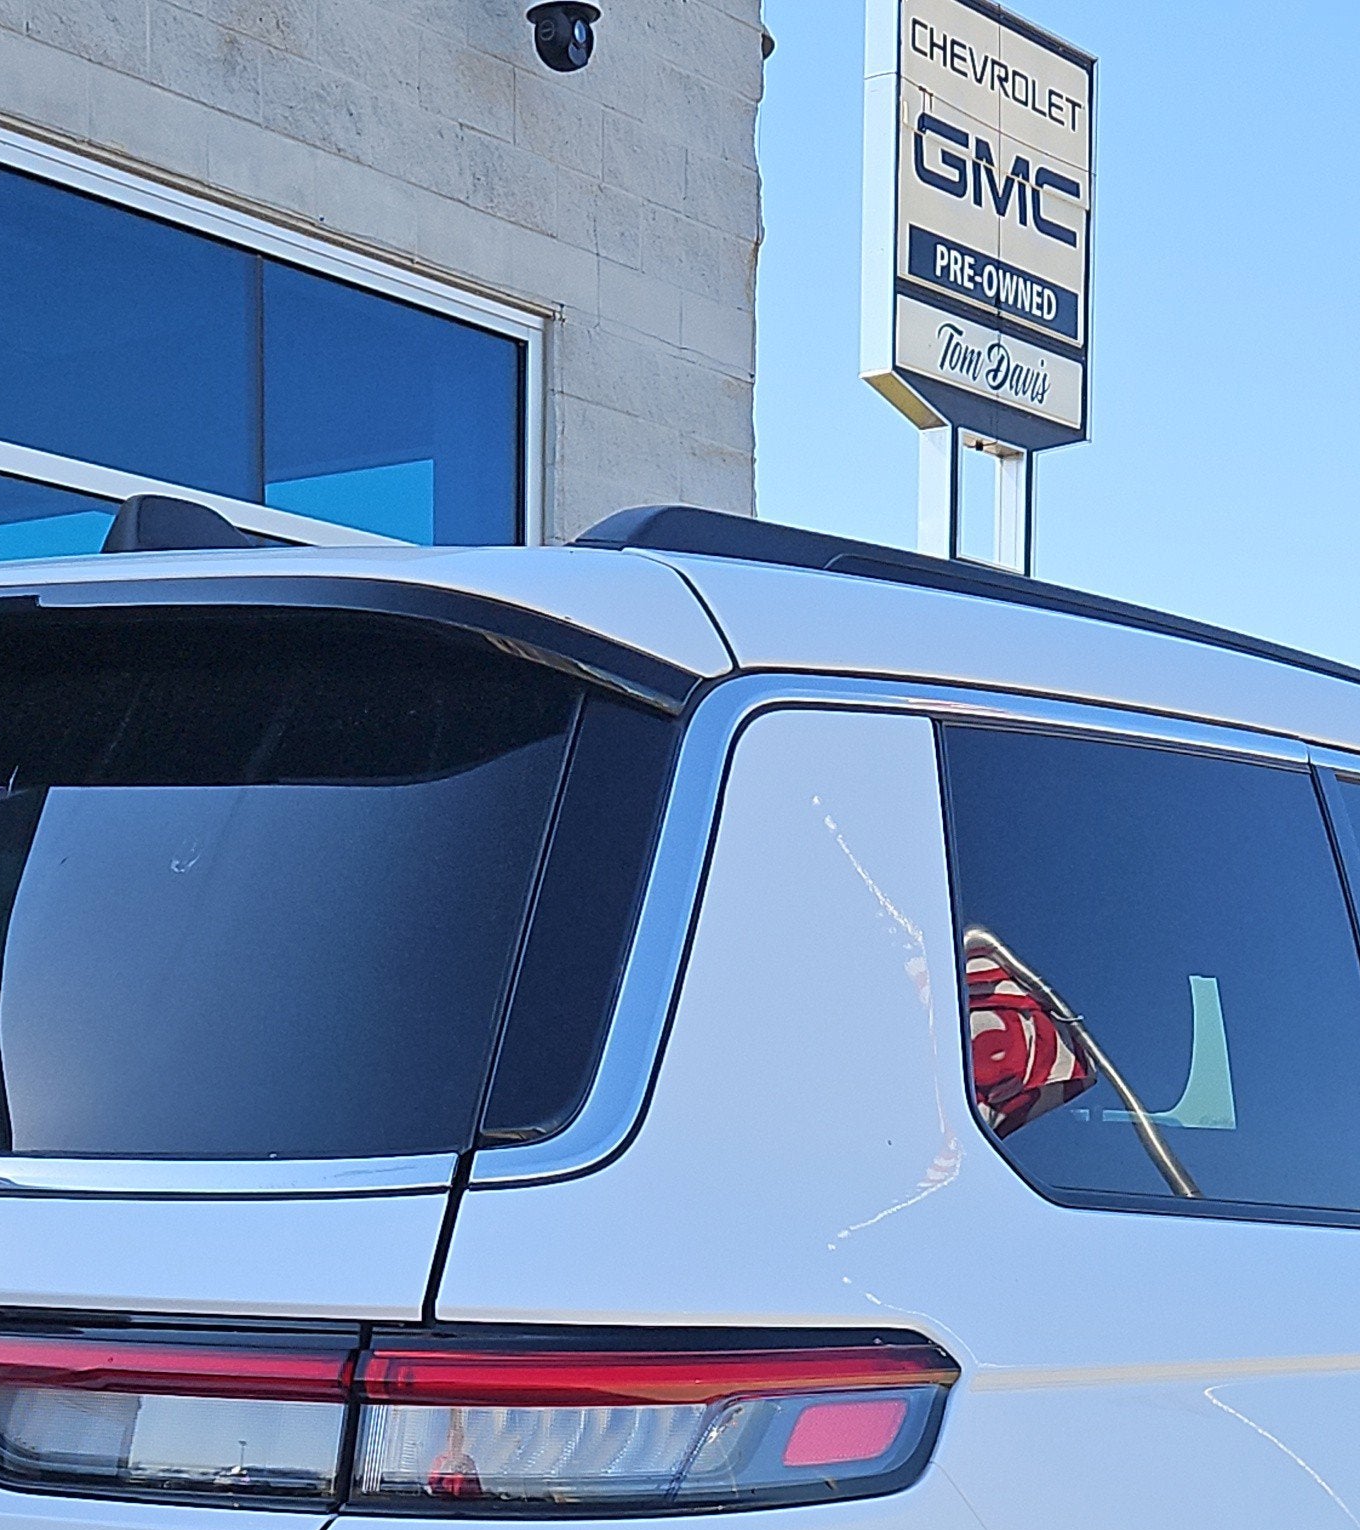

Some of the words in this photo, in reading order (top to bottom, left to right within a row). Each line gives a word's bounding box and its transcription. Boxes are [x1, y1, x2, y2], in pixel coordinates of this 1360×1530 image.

[911, 17, 1082, 132] CHEVROLET
[914, 112, 1081, 249] GMC
[935, 244, 1057, 322] PRE-OWNED
[938, 322, 986, 374] Tom
[986, 343, 1051, 404] Davis
